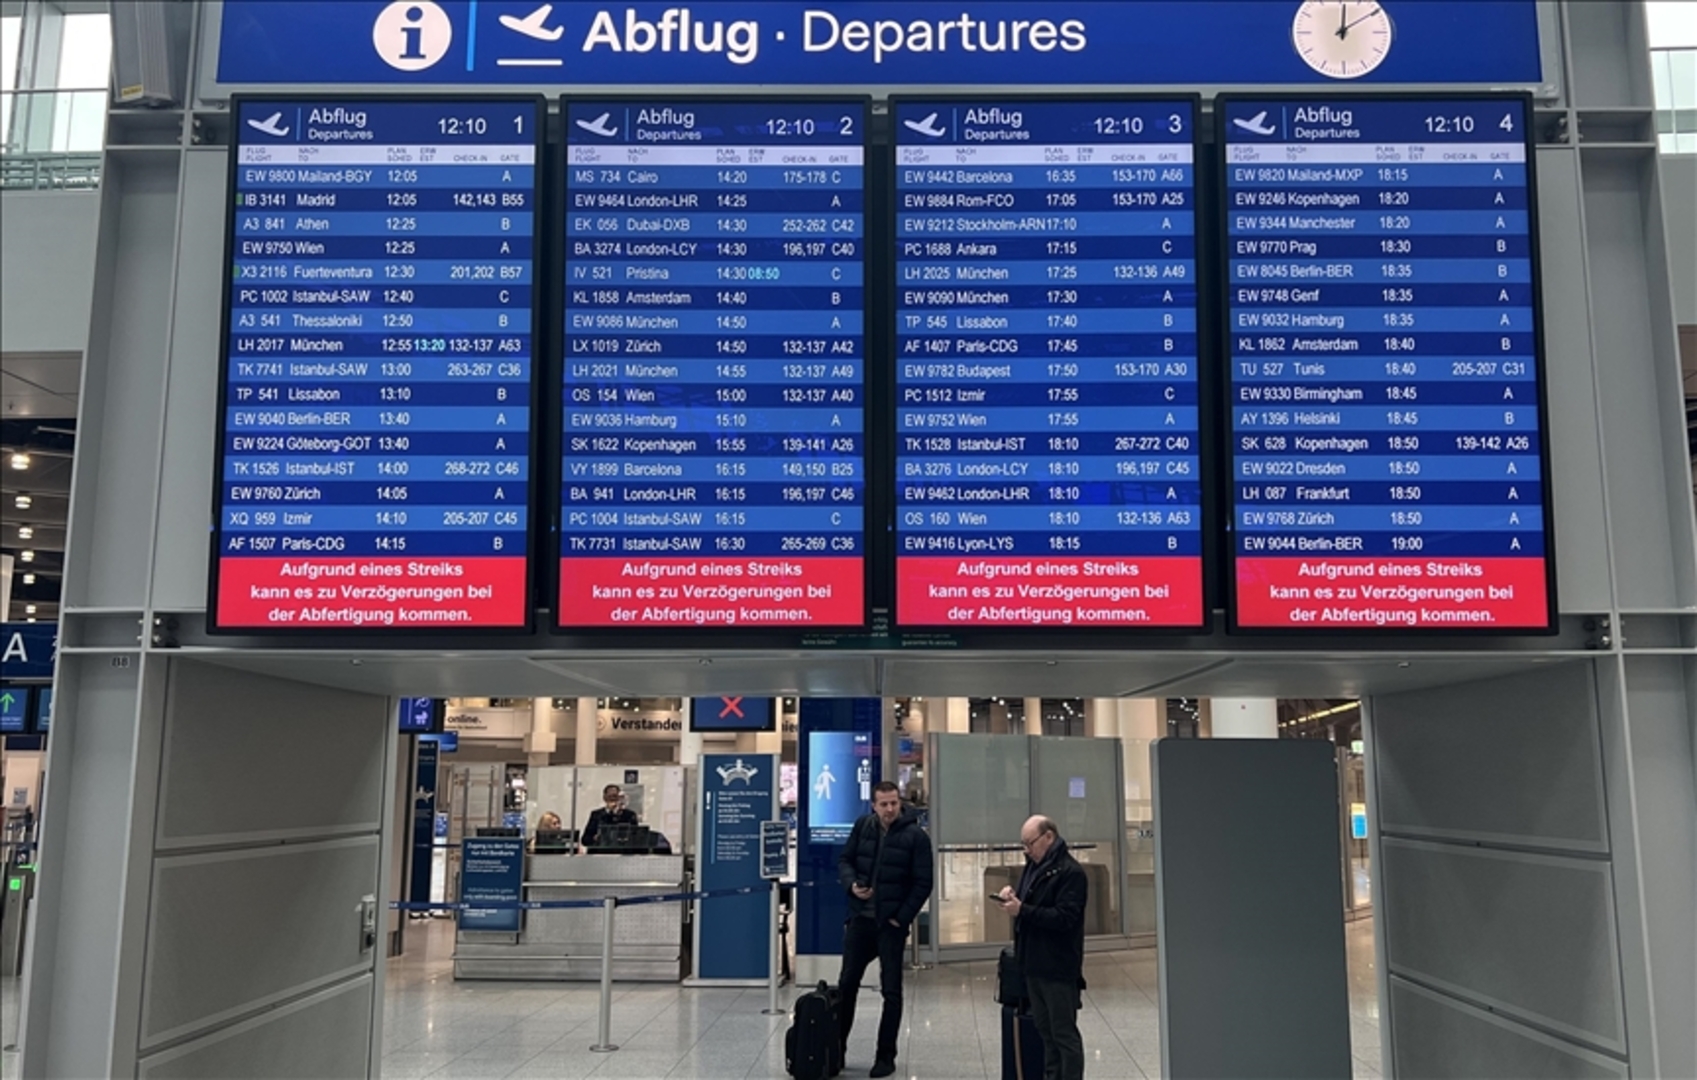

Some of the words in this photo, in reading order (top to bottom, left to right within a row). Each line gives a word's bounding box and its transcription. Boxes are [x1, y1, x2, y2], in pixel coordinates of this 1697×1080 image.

[583, 8, 758, 64] Abflug
[804, 10, 1086, 63] Departures
[308, 108, 366, 127] Abflug
[438, 118, 486, 133] 12:10
[514, 116, 521, 133] 1
[637, 108, 694, 128] Abflug
[766, 119, 814, 135] 12:10
[840, 116, 852, 134] 2
[964, 107, 1022, 128] Abflug
[1094, 117, 1142, 133] 12:10
[1169, 114, 1181, 132] 3
[1293, 106, 1352, 126] Abflug
[1425, 116, 1474, 132] 12:10
[1499, 114, 1513, 131] 4
[308, 128, 373, 141] Departures
[637, 129, 701, 141] Departures
[964, 129, 1029, 141] Departures
[1295, 127, 1360, 139] Departures
[576, 170, 593, 182] MS
[601, 170, 620, 182] 734
[628, 170, 657, 182] Cairo
[718, 170, 746, 182] 14:20
[784, 171, 826, 183] 175-178
[832, 170, 840, 182] C
[245, 194, 257, 205] IB
[259, 194, 285, 205] 3141
[296, 194, 335, 206] Madrid
[387, 193, 416, 205] 12:05
[453, 193, 496, 206] 142,143
[502, 193, 524, 205] B55
[905, 194, 925, 206] EW
[956, 193, 1014, 206] Rom-FCO
[1046, 193, 1076, 206] 17:05
[1113, 192, 1156, 205] 153-170
[1161, 192, 1184, 204] A25
[1237, 241, 1257, 253] EW
[1259, 240, 1287, 253] 9770
[1289, 240, 1316, 255] Prag
[1381, 239, 1411, 252] 18:30
[1496, 239, 1506, 252] B
[238, 339, 254, 350] LH
[257, 338, 284, 350] 2017
[290, 338, 343, 351] München
[382, 338, 412, 351] 12:55
[414, 338, 445, 351] 13:20
[449, 338, 493, 351] 132-137
[498, 339, 520, 351] A63
[905, 365, 925, 376] EW
[957, 364, 1010, 378] Budapest
[1048, 364, 1077, 376] 17:50
[1115, 363, 1158, 375] 153-170
[1164, 363, 1186, 375] A30
[1241, 363, 1256, 374] TU
[1263, 363, 1283, 374] 527
[1294, 362, 1324, 374] Tunis
[1385, 362, 1416, 374] 18:40
[1452, 362, 1496, 374] 205-207
[1502, 362, 1524, 374] C31
[572, 414, 591, 425] EW
[625, 414, 676, 428] Hamburg
[716, 414, 745, 426] 15:10
[832, 414, 840, 425] A
[1241, 436, 1258, 449] SK
[1264, 436, 1286, 449] 628
[1295, 437, 1368, 452] Kopenhagen
[1388, 436, 1418, 449] 18:50
[1456, 436, 1501, 449] 139-142
[1505, 436, 1528, 449] A26
[228, 537, 245, 549] AF
[248, 537, 276, 550] 1507
[282, 536, 345, 550] Paris-CDG
[375, 537, 405, 549] 14:15
[493, 536, 503, 549] B
[570, 537, 585, 549] TK
[589, 537, 615, 549] 7731
[623, 537, 701, 550] Istanbul-SAW
[715, 537, 745, 550] 16:30
[905, 536, 925, 549] EW
[958, 536, 1013, 552] Lyon-LYS
[1049, 536, 1080, 549] 18:15
[1167, 536, 1177, 549] B
[1244, 536, 1265, 549] EW
[1267, 536, 1295, 549] 9044
[1298, 536, 1362, 550] Berlin-BER
[1391, 536, 1422, 550] 19:00
[1510, 537, 1520, 549] A
[280, 563, 355, 579] Aufgrund
[359, 563, 403, 575] eines
[407, 563, 463, 575] Streiks
[622, 563, 696, 579] Aufgrund
[700, 563, 743, 575] eines
[747, 563, 802, 575] Streiks
[957, 563, 1031, 578] Aufgrund
[1035, 563, 1078, 575] eines
[1083, 563, 1138, 575] Streiks
[1298, 563, 1374, 579] Aufgrund
[1378, 563, 1422, 576] eines
[1426, 563, 1482, 576] Streiks
[250, 585, 289, 598] kann
[294, 587, 312, 598] es
[317, 588, 336, 598] zu
[340, 585, 463, 601] Verzögerungen
[467, 585, 491, 597] bei
[592, 585, 631, 598] kann
[636, 587, 654, 598] es
[659, 587, 677, 597] zu
[682, 584, 802, 601] Verzögerungen
[807, 585, 831, 597] bei
[929, 584, 967, 597] kann
[972, 587, 990, 597] es
[995, 587, 1013, 597] zu
[1017, 584, 1139, 601] Verzögerungen
[1144, 585, 1168, 597] bei
[1270, 585, 1309, 598] kann
[1313, 587, 1333, 598] es
[1337, 588, 1356, 598] zu
[1361, 585, 1484, 602] Verzögerungen
[1488, 585, 1513, 598] bei
[268, 608, 295, 620] der
[298, 607, 393, 624] Abfertigung
[398, 607, 471, 620] kommen.
[611, 607, 637, 620] der
[641, 607, 735, 624] Abfertigung
[740, 607, 811, 620] kommen.
[947, 607, 974, 619] der
[978, 607, 1071, 623] Abfertigung
[1076, 607, 1149, 620] kommen.
[1289, 608, 1317, 620] der
[1321, 607, 1416, 625] Abfertigung
[1421, 608, 1494, 621] kommen.
[2, 633, 28, 662] A
[447, 715, 482, 725] online.
